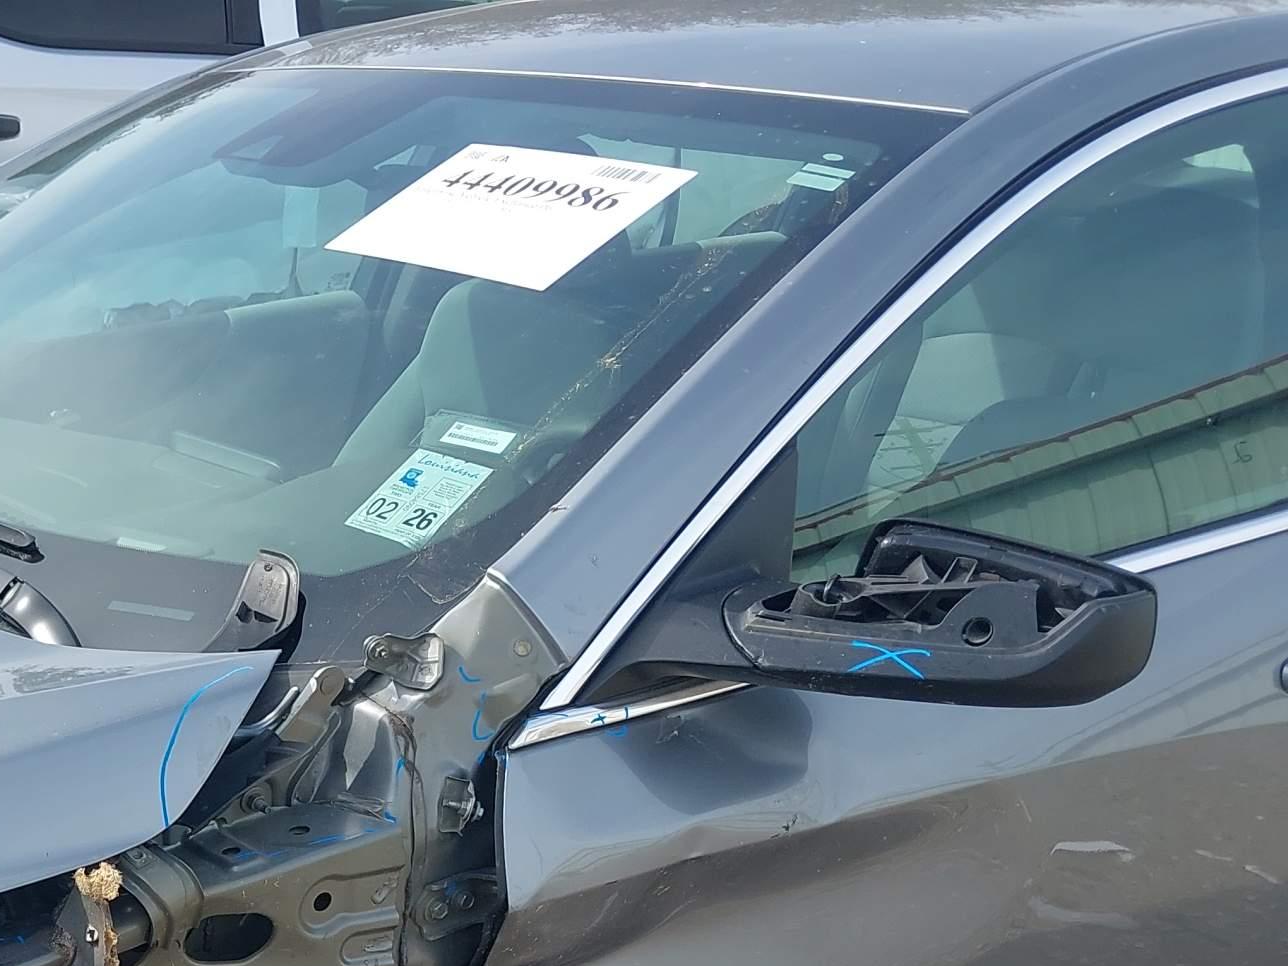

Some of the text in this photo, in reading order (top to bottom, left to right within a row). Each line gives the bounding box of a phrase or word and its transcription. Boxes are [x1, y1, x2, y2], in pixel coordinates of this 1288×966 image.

[442, 169, 632, 212] 44409986
[417, 454, 479, 480] Louisiana
[365, 497, 399, 521] 02
[402, 507, 438, 531] 26
